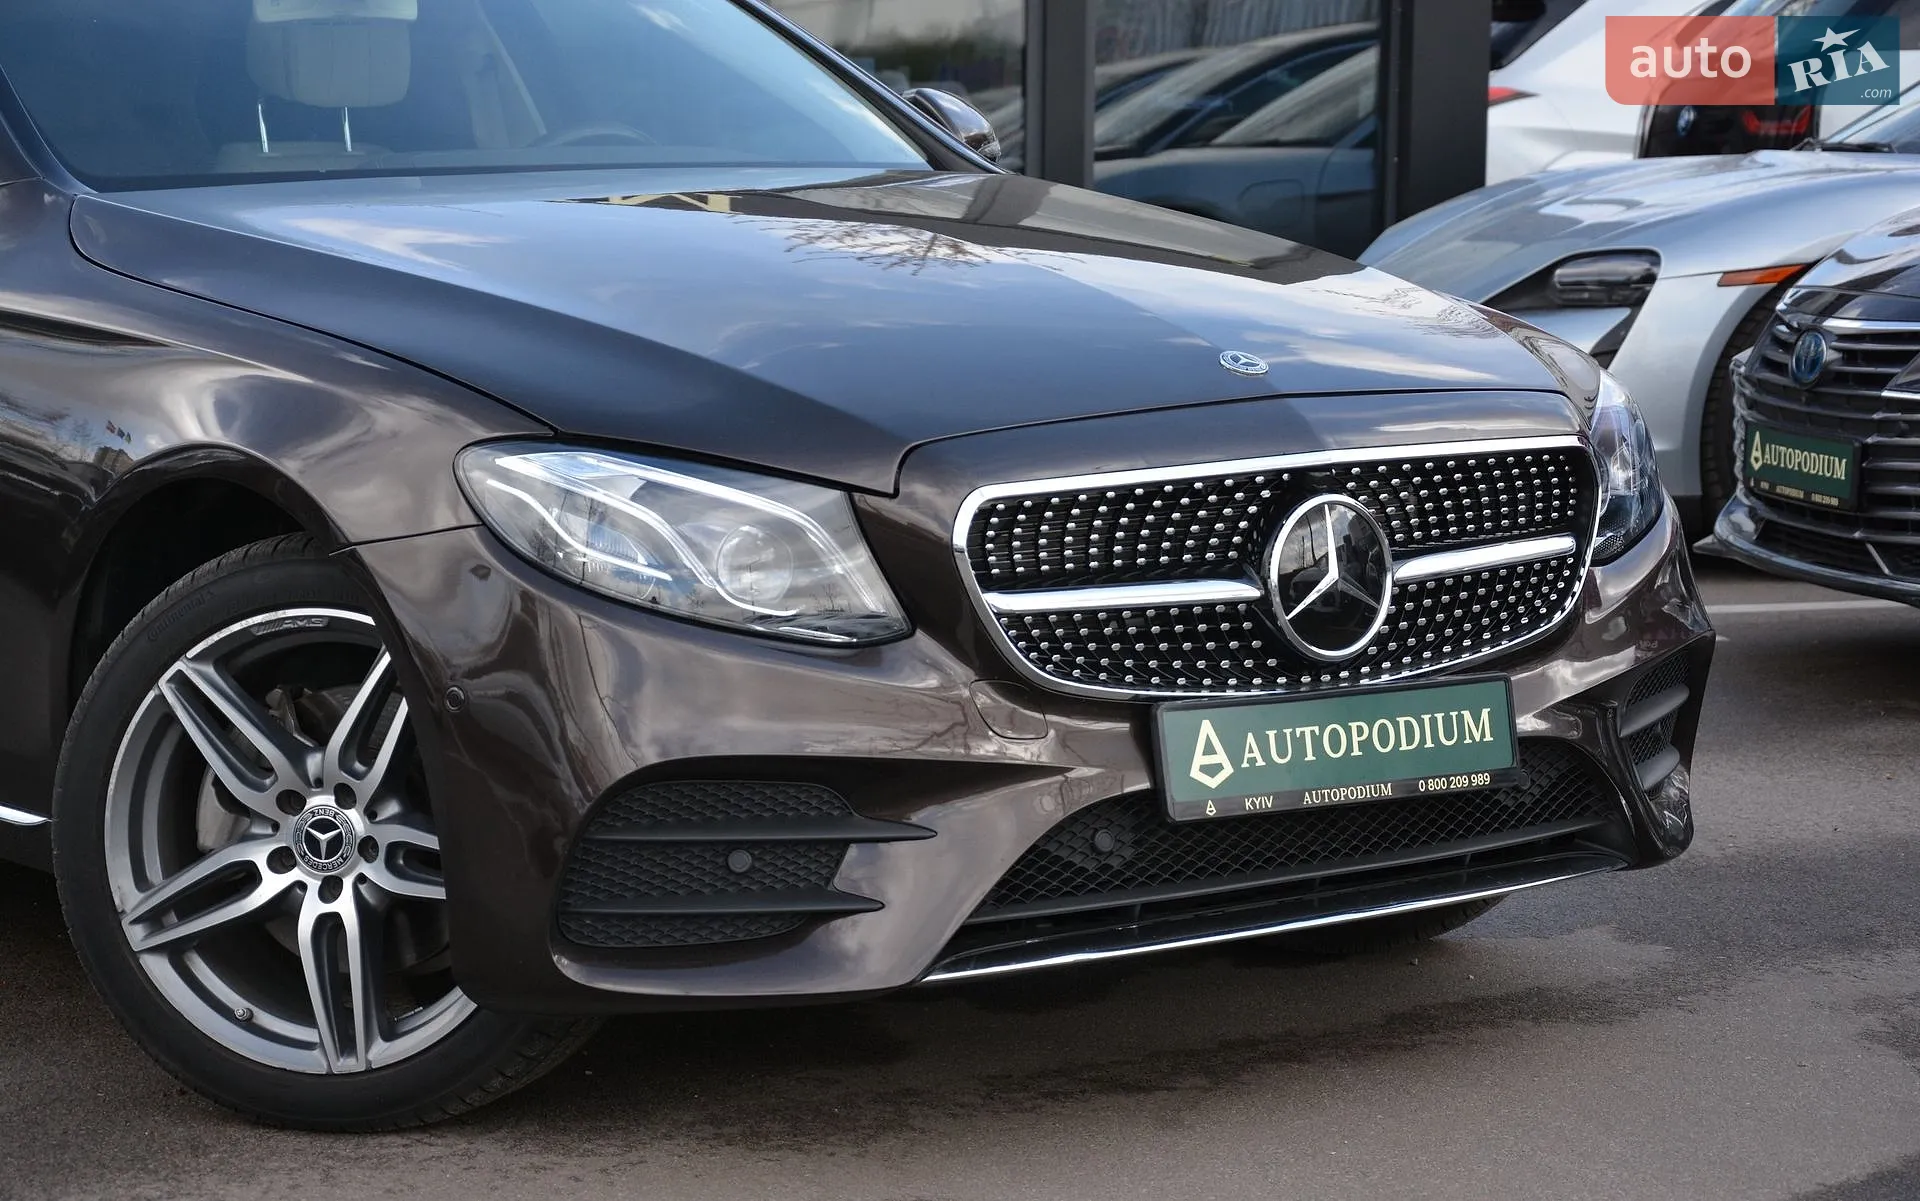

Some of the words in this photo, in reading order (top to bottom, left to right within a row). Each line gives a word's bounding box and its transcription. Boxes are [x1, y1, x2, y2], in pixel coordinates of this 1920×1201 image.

[1763, 443, 1847, 480] AUTOPODIUM
[1241, 708, 1494, 768] AUTOPODIUM
[1244, 796, 1274, 811] KYIV
[1303, 783, 1393, 805] AUTOPODIUM
[1418, 779, 1426, 792] 0
[1427, 777, 1447, 791] 800
[1449, 775, 1469, 790] 209
[1470, 773, 1491, 787] 989
[313, 808, 335, 817] BENZ
[303, 855, 344, 871] MERCEDES
